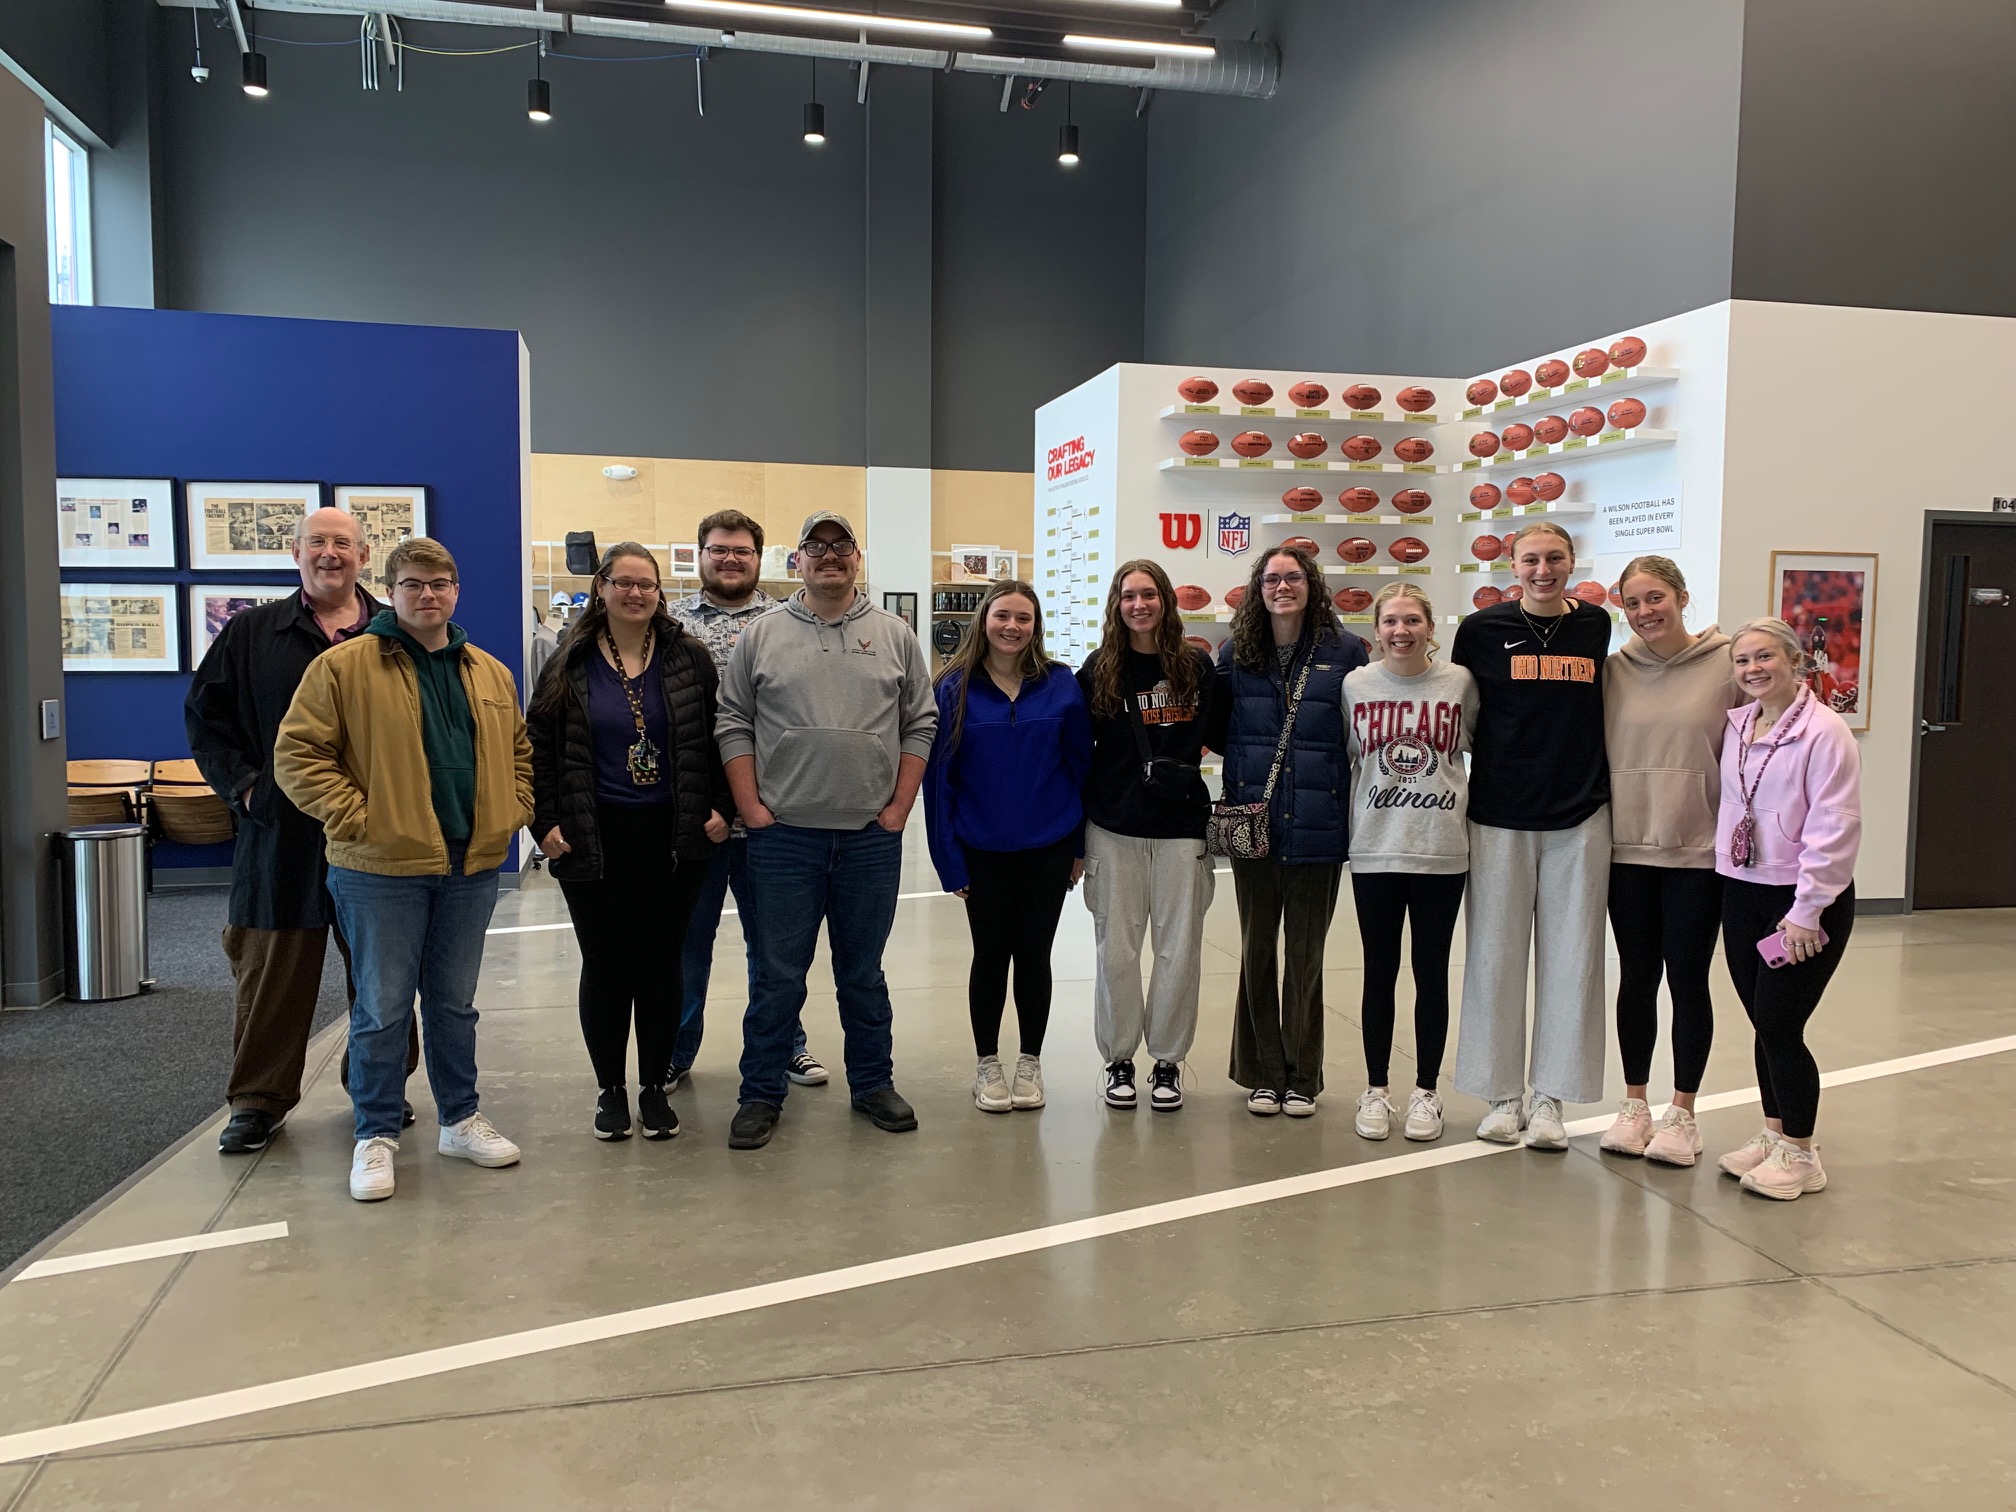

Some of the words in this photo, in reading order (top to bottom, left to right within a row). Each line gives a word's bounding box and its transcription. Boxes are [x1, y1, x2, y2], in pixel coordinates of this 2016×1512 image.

[1047, 435, 1085, 464] CRAFTING
[1047, 463, 1063, 481] OUR
[1064, 449, 1096, 475] LEGACY
[1608, 503, 1631, 513] WILSON
[1631, 499, 1661, 511] FOOTBALL
[1661, 498, 1675, 506] HAS
[1995, 500, 2015, 510] 104
[1609, 517, 1624, 525] BEEN
[1624, 514, 1647, 524] PLAYED
[1647, 513, 1654, 521] IN
[1655, 511, 1675, 520] EVERY
[1220, 530, 1247, 550] NFL
[1614, 528, 1635, 537] SINGLE
[1636, 526, 1655, 535] SUPER
[1656, 525, 1674, 534] BOWL
[1511, 655, 1538, 680] OHIO
[1539, 655, 1595, 683] NORTHERN
[1353, 701, 1462, 766] CHICAGO
[1398, 776, 1417, 784] 1837
[1366, 785, 1457, 810] Illinois
